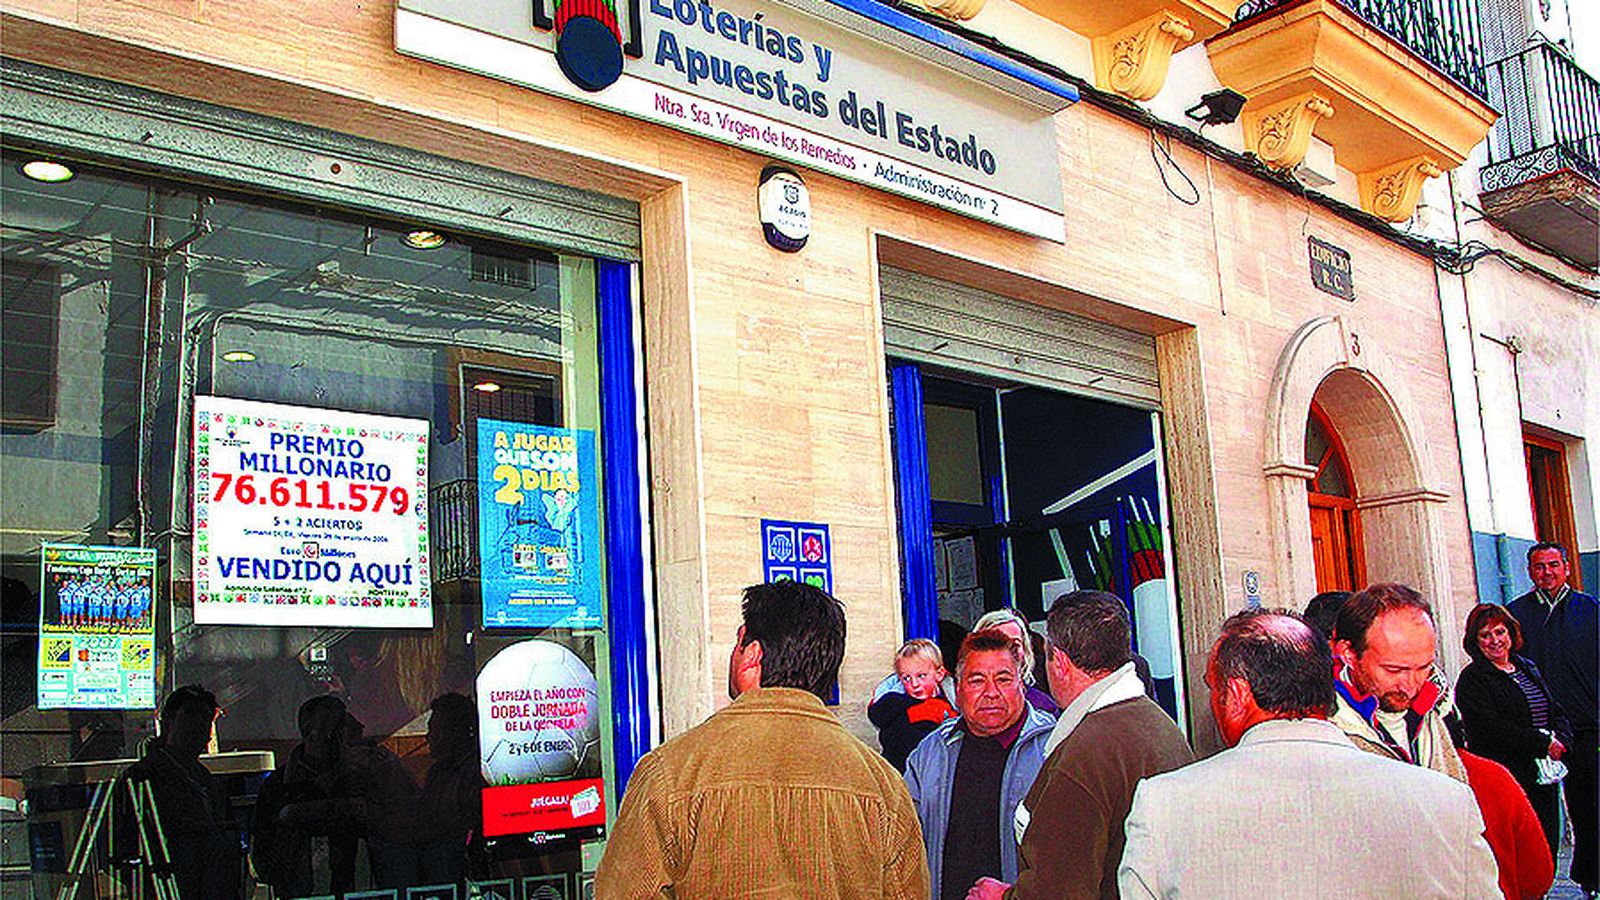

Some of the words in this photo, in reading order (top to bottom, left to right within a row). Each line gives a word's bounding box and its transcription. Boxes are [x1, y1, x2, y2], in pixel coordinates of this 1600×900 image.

[812, 43, 833, 83] y
[654, 29, 830, 119] Apuestas
[838, 90, 888, 140] del
[895, 111, 997, 176] Estado
[654, 92, 687, 119] Ntra.
[690, 103, 714, 128] Sra.
[715, 111, 760, 142] Virgen
[761, 125, 779, 148] de
[781, 131, 799, 153] los
[800, 137, 857, 171] Remedios
[873, 162, 972, 207] Administración
[990, 198, 999, 216] 2
[1350, 332, 1361, 358] 3
[270, 431, 365, 460] PREMIO
[493, 430, 510, 450] A
[512, 431, 578, 454] JUGAR
[239, 451, 392, 483] MILLONARIO
[211, 471, 410, 516] 76.611.579
[493, 463, 525, 506] 2
[274, 516, 281, 527] 5
[306, 517, 364, 532] ACIERTOS
[216, 556, 342, 583] VENDIDO
[348, 557, 414, 589] AQUÍ
[490, 688, 532, 703] EMPIEZA
[544, 685, 566, 699] AÑO
[490, 703, 530, 719] DOBLE
[531, 701, 588, 718] JORNADA
[519, 720, 532, 732] LA
[508, 742, 516, 755] 2
